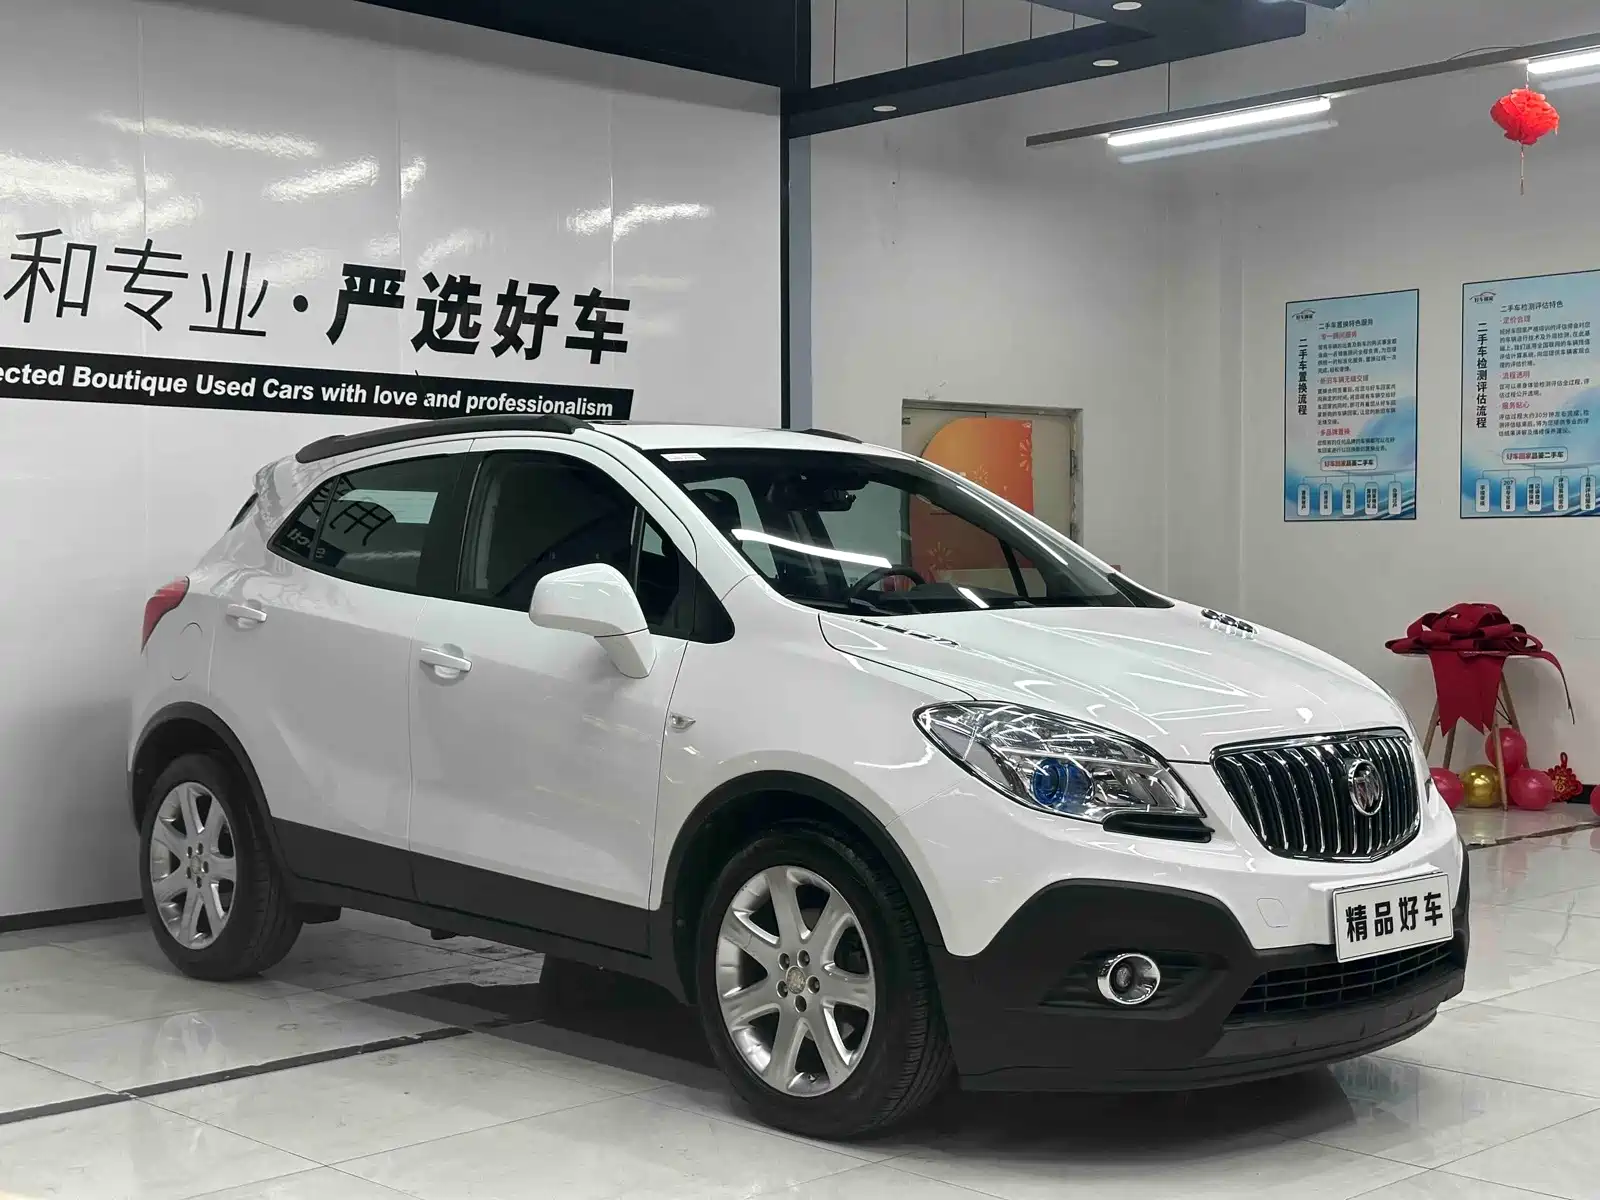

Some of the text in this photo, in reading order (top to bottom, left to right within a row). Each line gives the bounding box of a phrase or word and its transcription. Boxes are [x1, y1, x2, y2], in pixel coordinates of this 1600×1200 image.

[72, 365, 188, 397] Boutique
[196, 374, 256, 397] Used
[263, 378, 314, 401] Cars
[321, 383, 367, 404] with
[373, 386, 418, 406] love
[424, 390, 461, 409] and
[465, 393, 613, 417] professionalism
[1298, 338, 1308, 416] 二手车置换流程
[1476, 322, 1488, 429] 二手车检测评估流程
[1346, 892, 1443, 942] 精品好车
